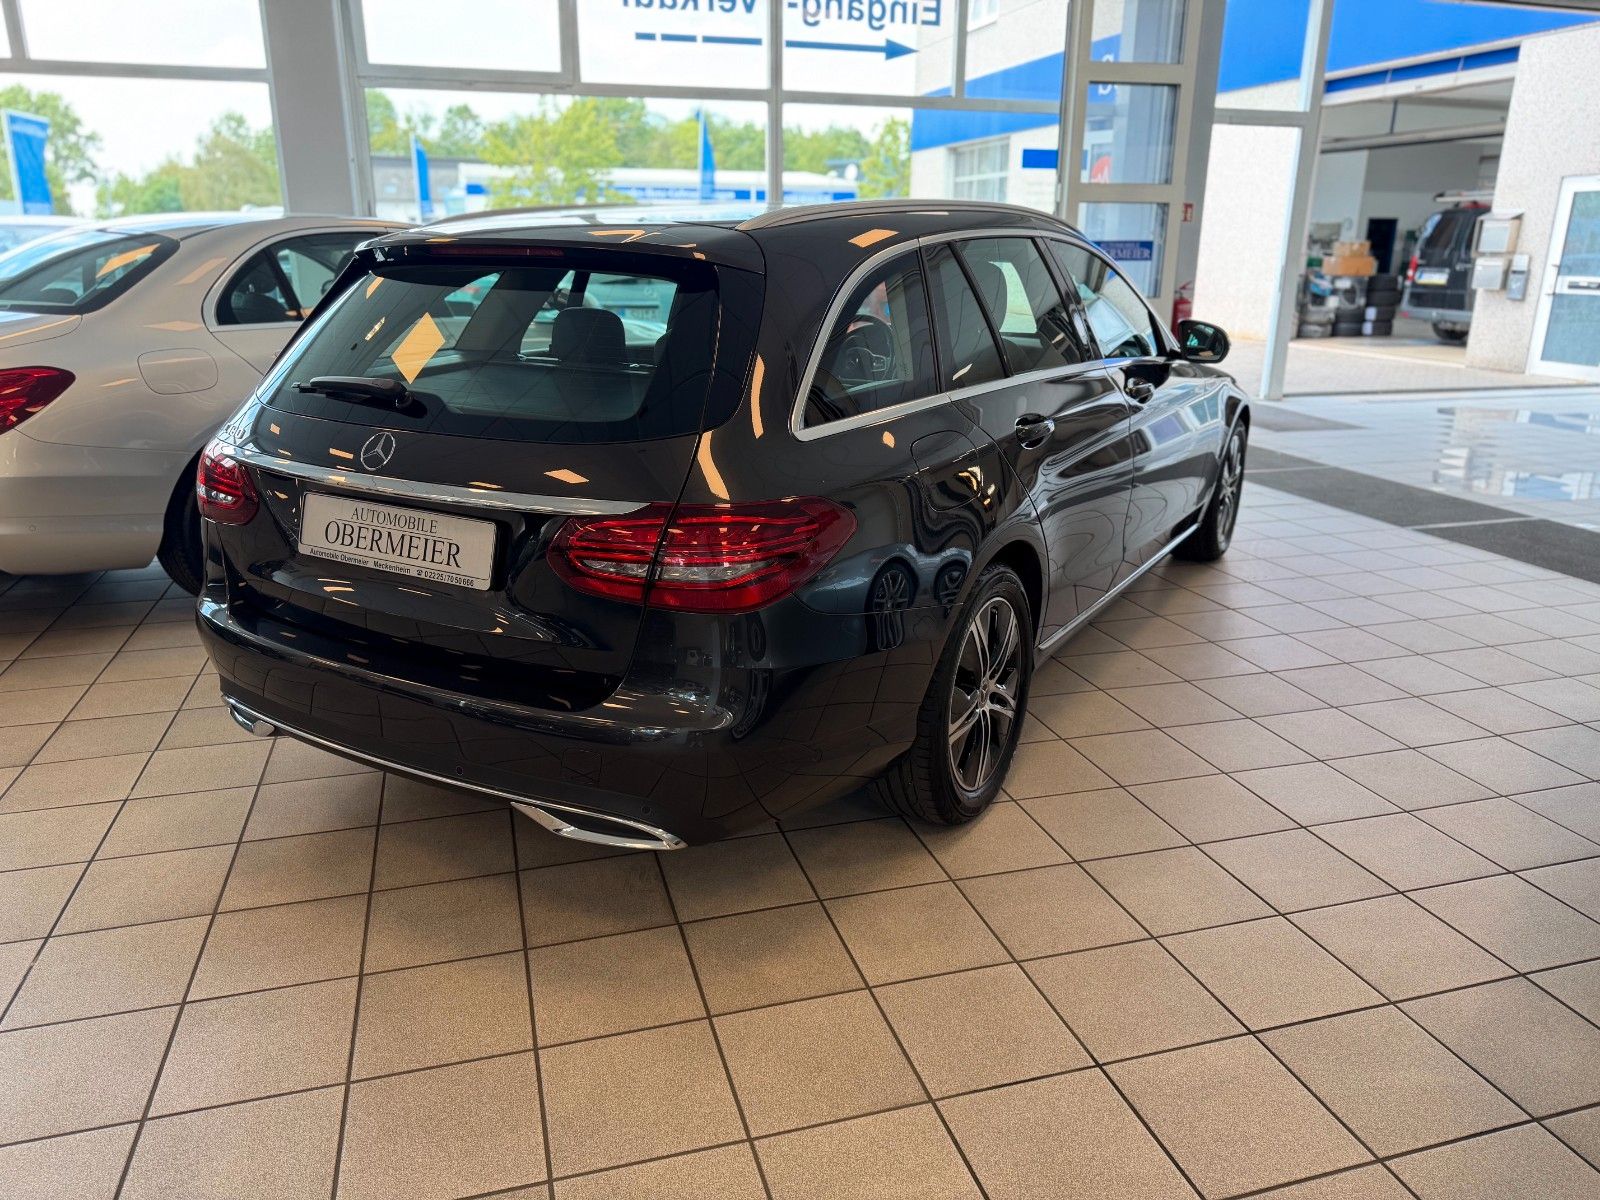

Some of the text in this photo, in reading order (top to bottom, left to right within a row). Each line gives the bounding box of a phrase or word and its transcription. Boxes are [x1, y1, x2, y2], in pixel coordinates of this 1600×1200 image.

[351, 507, 438, 534] AUTOMOBILE
[325, 520, 461, 569] OBERMEIER
[310, 548, 339, 560] Automobile
[340, 553, 369, 566] Obermeier
[373, 560, 411, 574] Meckenheim
